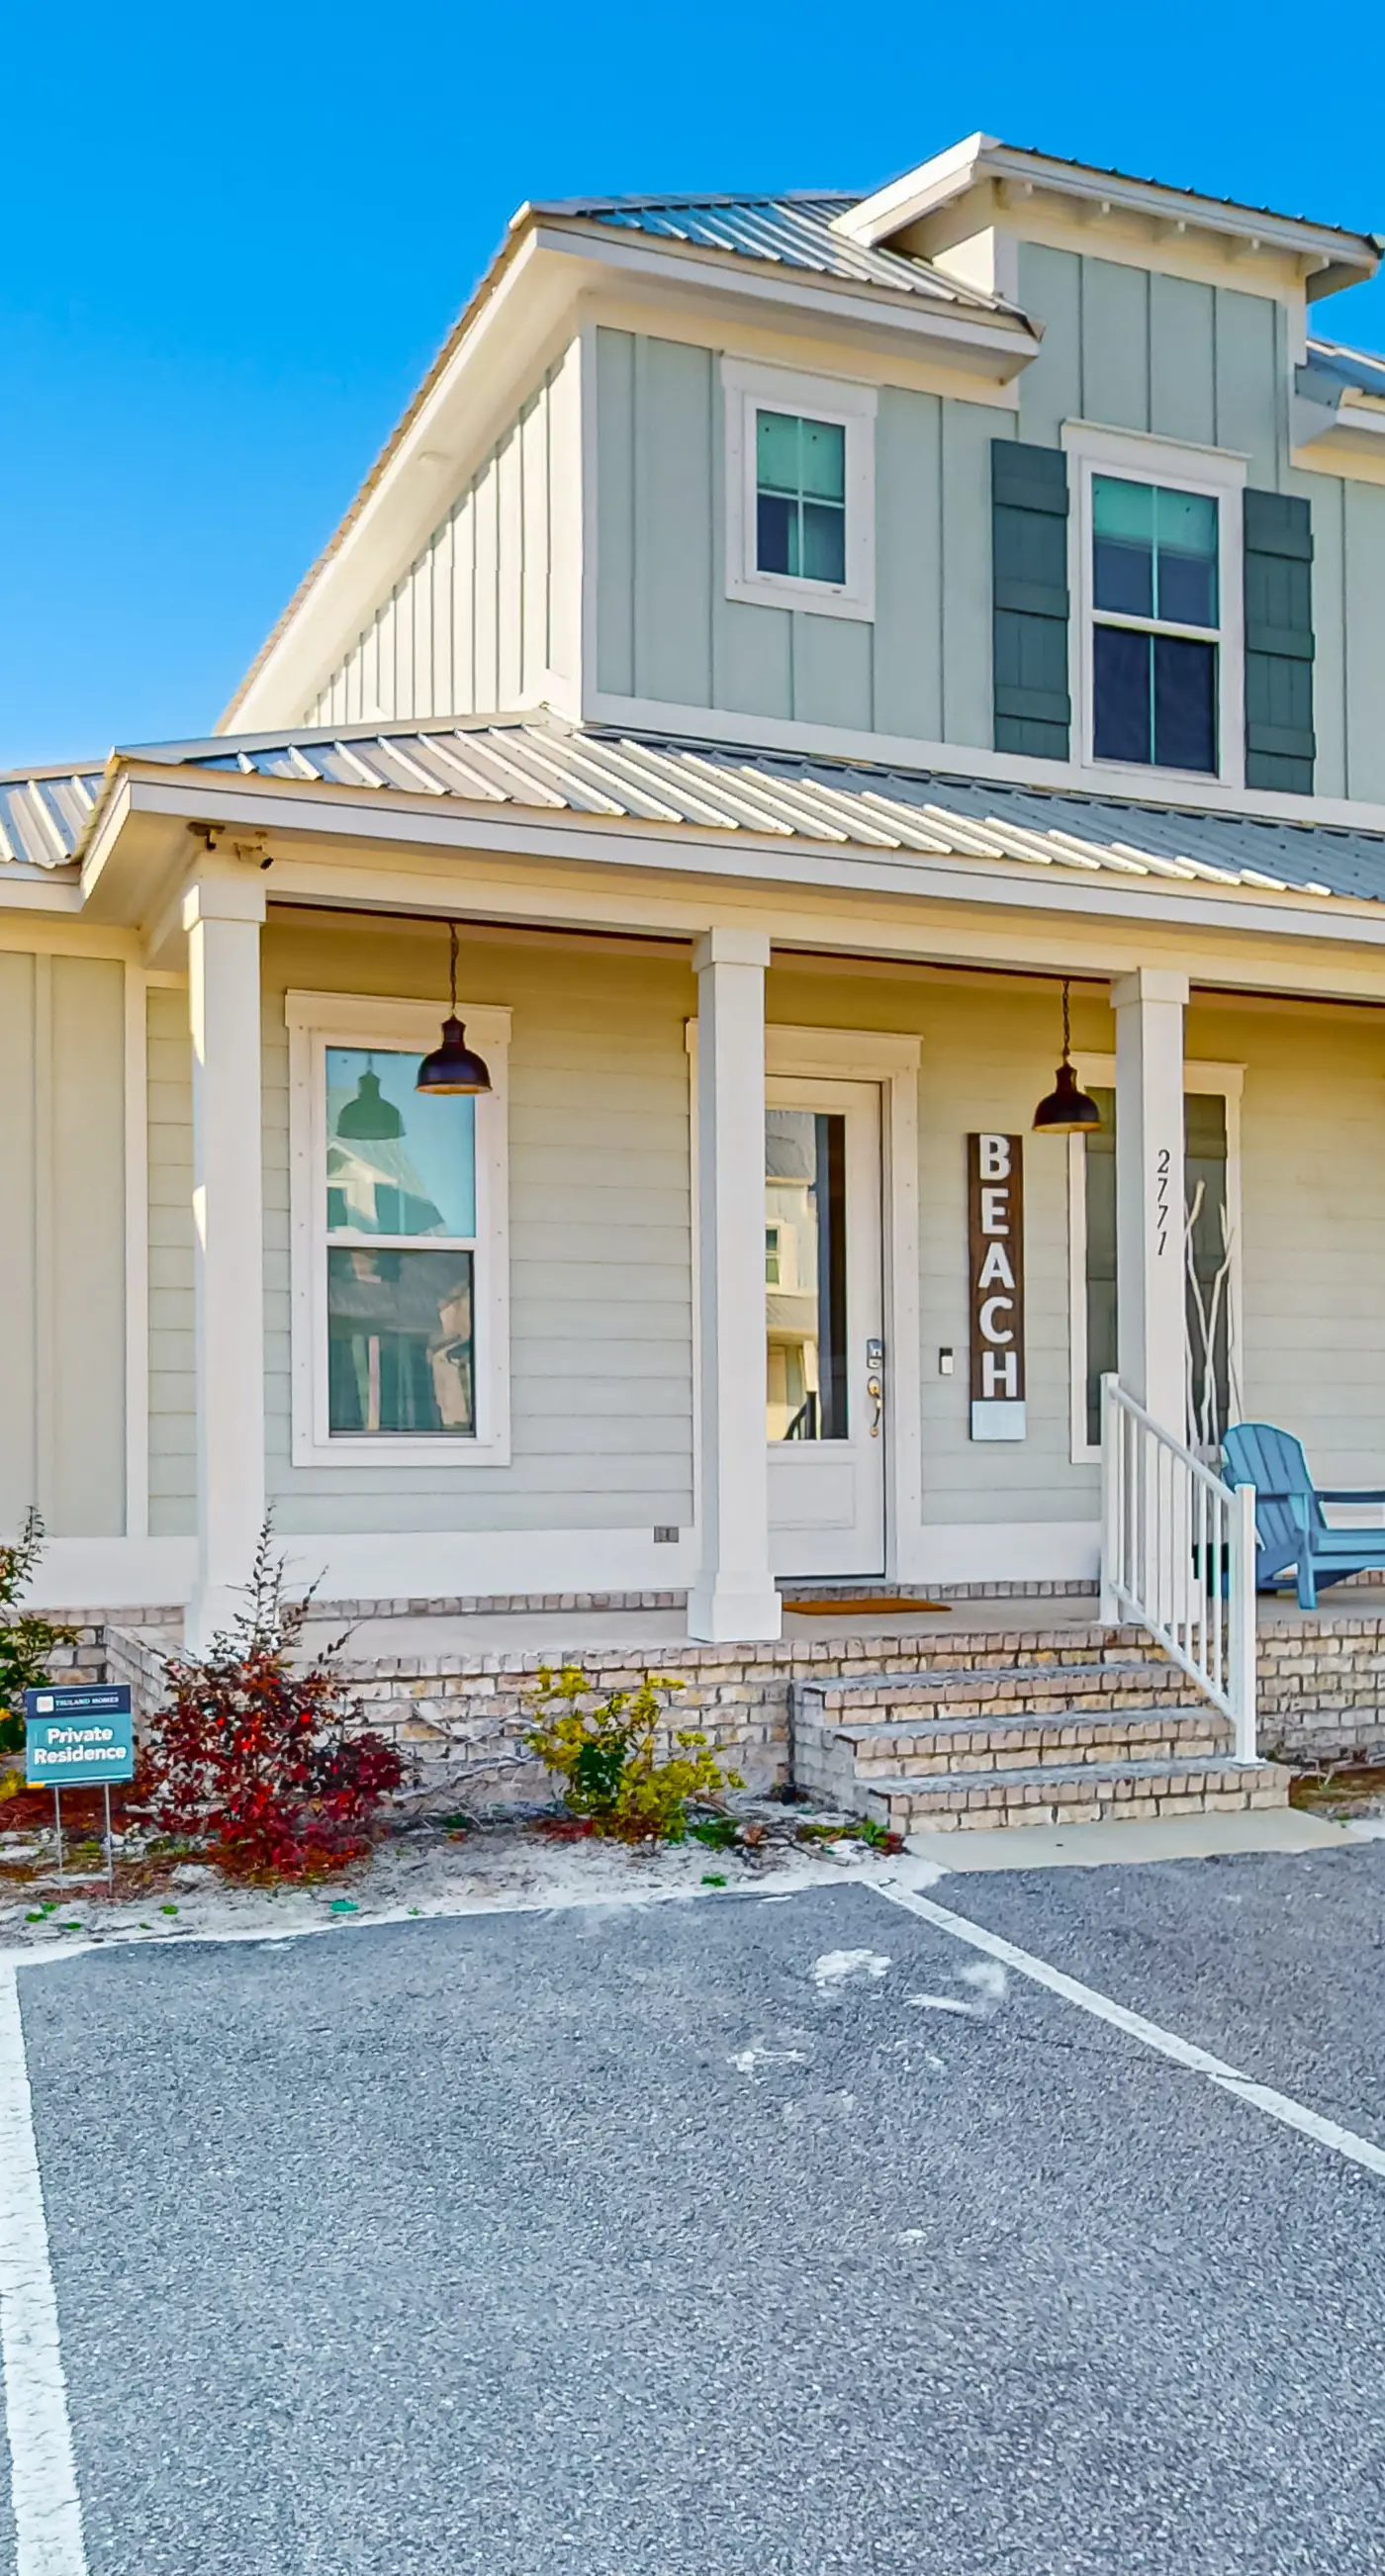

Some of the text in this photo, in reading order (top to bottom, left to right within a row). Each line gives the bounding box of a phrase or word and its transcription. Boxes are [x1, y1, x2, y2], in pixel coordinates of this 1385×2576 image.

[1156, 1149, 1170, 1255] 2771
[978, 1134, 1017, 1398] BEACH
[34, 1745, 127, 1765] Residence
[46, 1726, 113, 1744] Private
